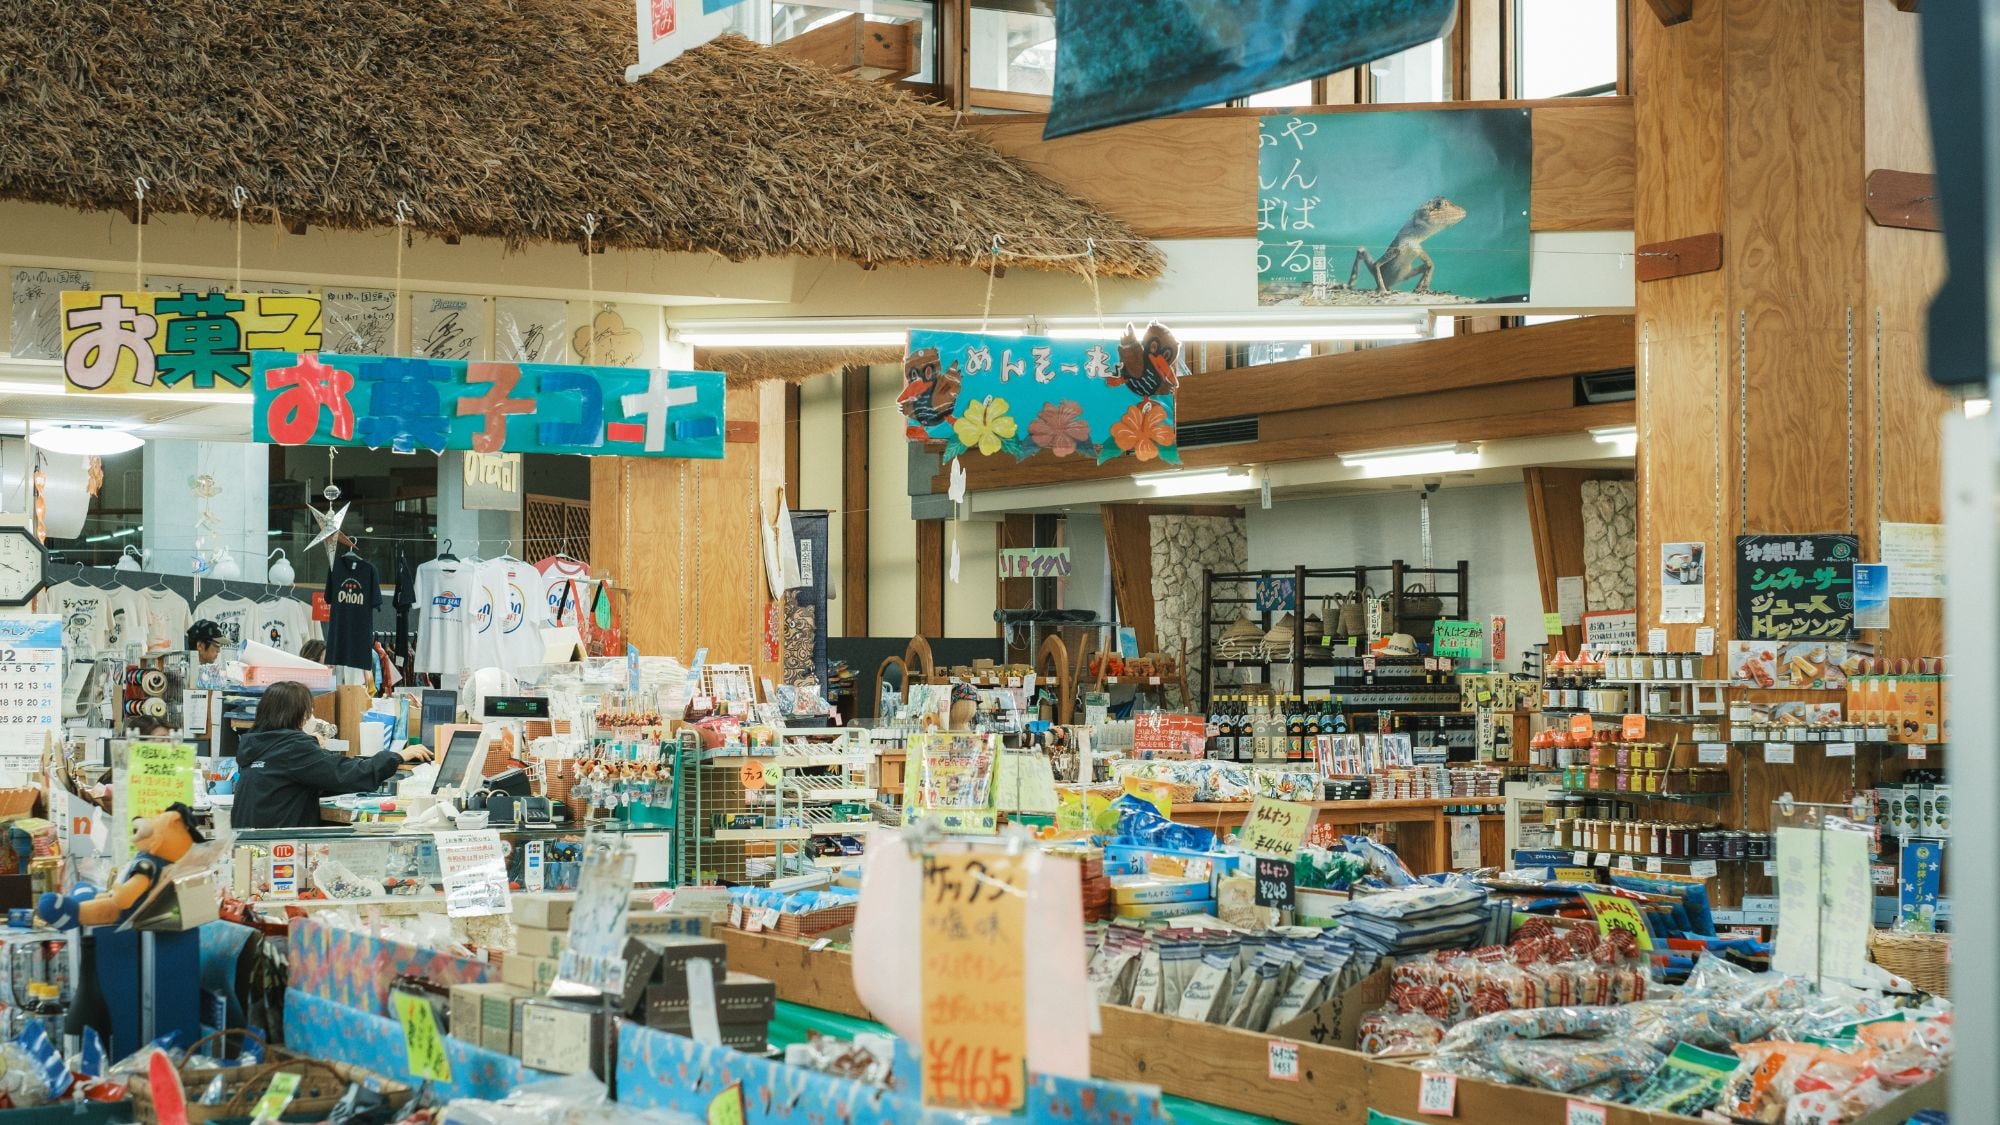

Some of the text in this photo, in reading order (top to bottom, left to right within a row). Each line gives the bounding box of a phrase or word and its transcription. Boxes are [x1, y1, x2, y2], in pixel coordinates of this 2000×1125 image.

[1279, 116, 1319, 273] やんばる
[64, 292, 323, 391] お菓子
[965, 345, 1124, 385] めんそーれ
[265, 352, 720, 455] お菓子コーナー
[1744, 540, 1816, 563] 沖縄県産
[338, 588, 364, 605] Orion
[548, 594, 575, 610] Oron
[1750, 591, 1837, 616] ジュース
[1, 665, 50, 673] 4 5 6 7
[743, 768, 763, 782] チョコ
[764, 767, 779, 780] ガム
[1257, 806, 1292, 827] ちんすこう
[1255, 834, 1294, 856] ¥464
[1259, 861, 1290, 879] ちんすこう
[1147, 888, 1176, 898] ちんすこう
[1260, 879, 1288, 900] ¥248
[928, 1036, 1012, 1108] ¥465
